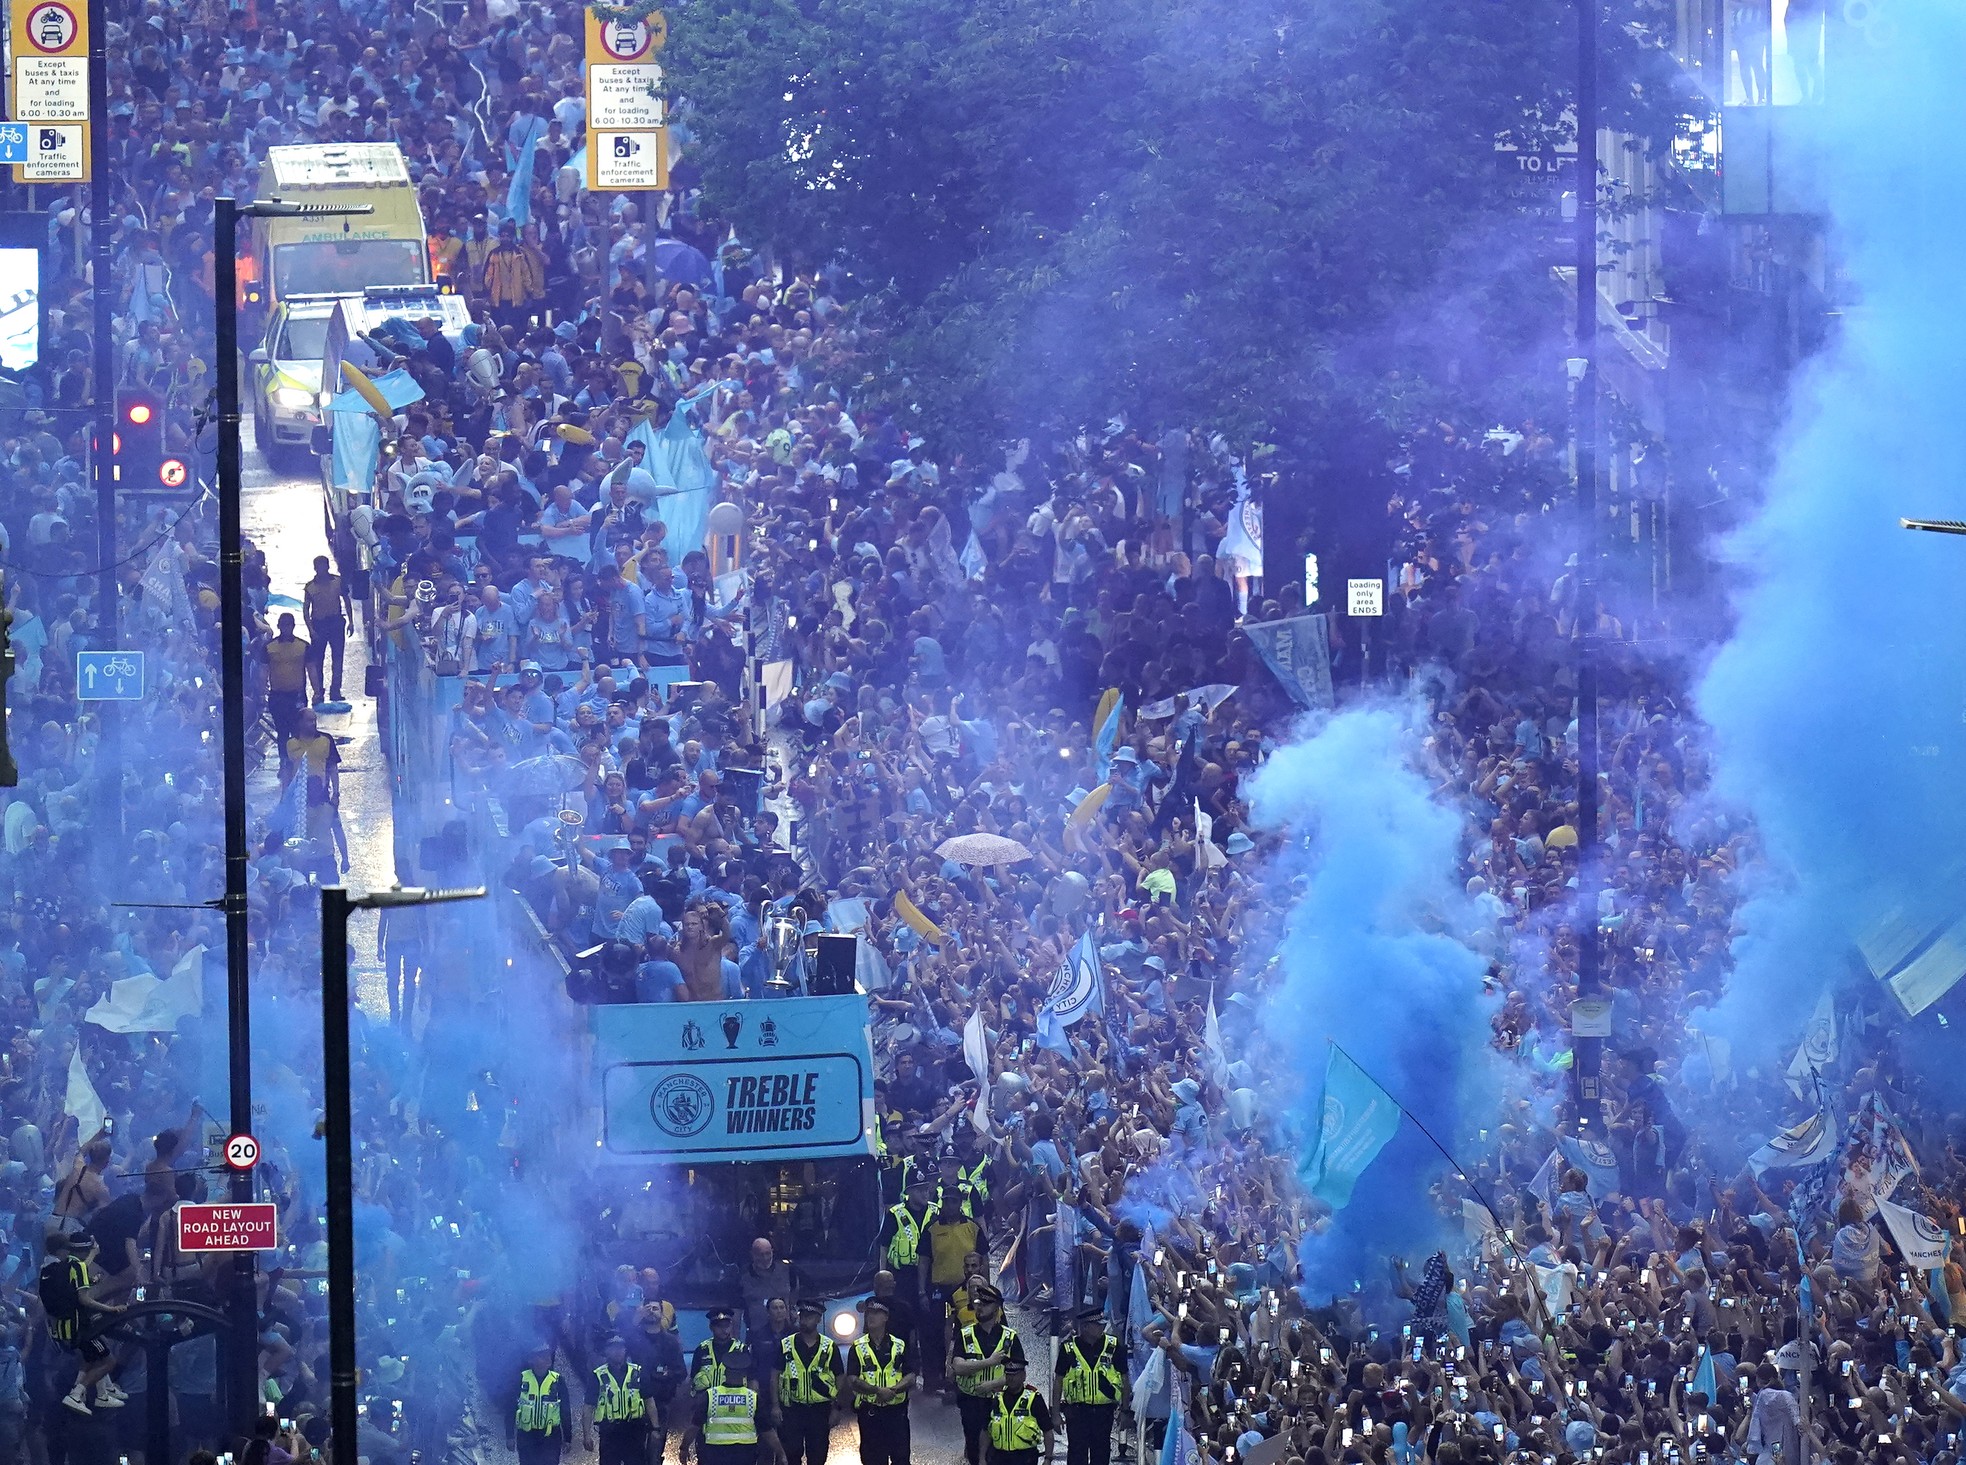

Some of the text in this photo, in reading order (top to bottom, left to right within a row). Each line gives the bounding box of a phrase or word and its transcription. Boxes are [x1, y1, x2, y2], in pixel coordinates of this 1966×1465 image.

[38, 61, 66, 69] Except
[612, 68, 640, 76] Except
[44, 100, 75, 108] loading
[619, 107, 649, 115] loading
[1516, 156, 1541, 172] TO
[302, 231, 390, 242] AMBULANCE
[1356, 590, 1373, 598] only
[657, 1078, 708, 1098] MANCHESTER
[727, 1073, 819, 1109] TREBLE
[727, 1106, 816, 1134] WINNERS
[231, 1144, 255, 1158] 20
[213, 1210, 242, 1220] NEW
[184, 1222, 271, 1233] ROAD LAYOUT
[205, 1235, 249, 1246] AHEAD
[720, 1396, 746, 1404] POLICE
